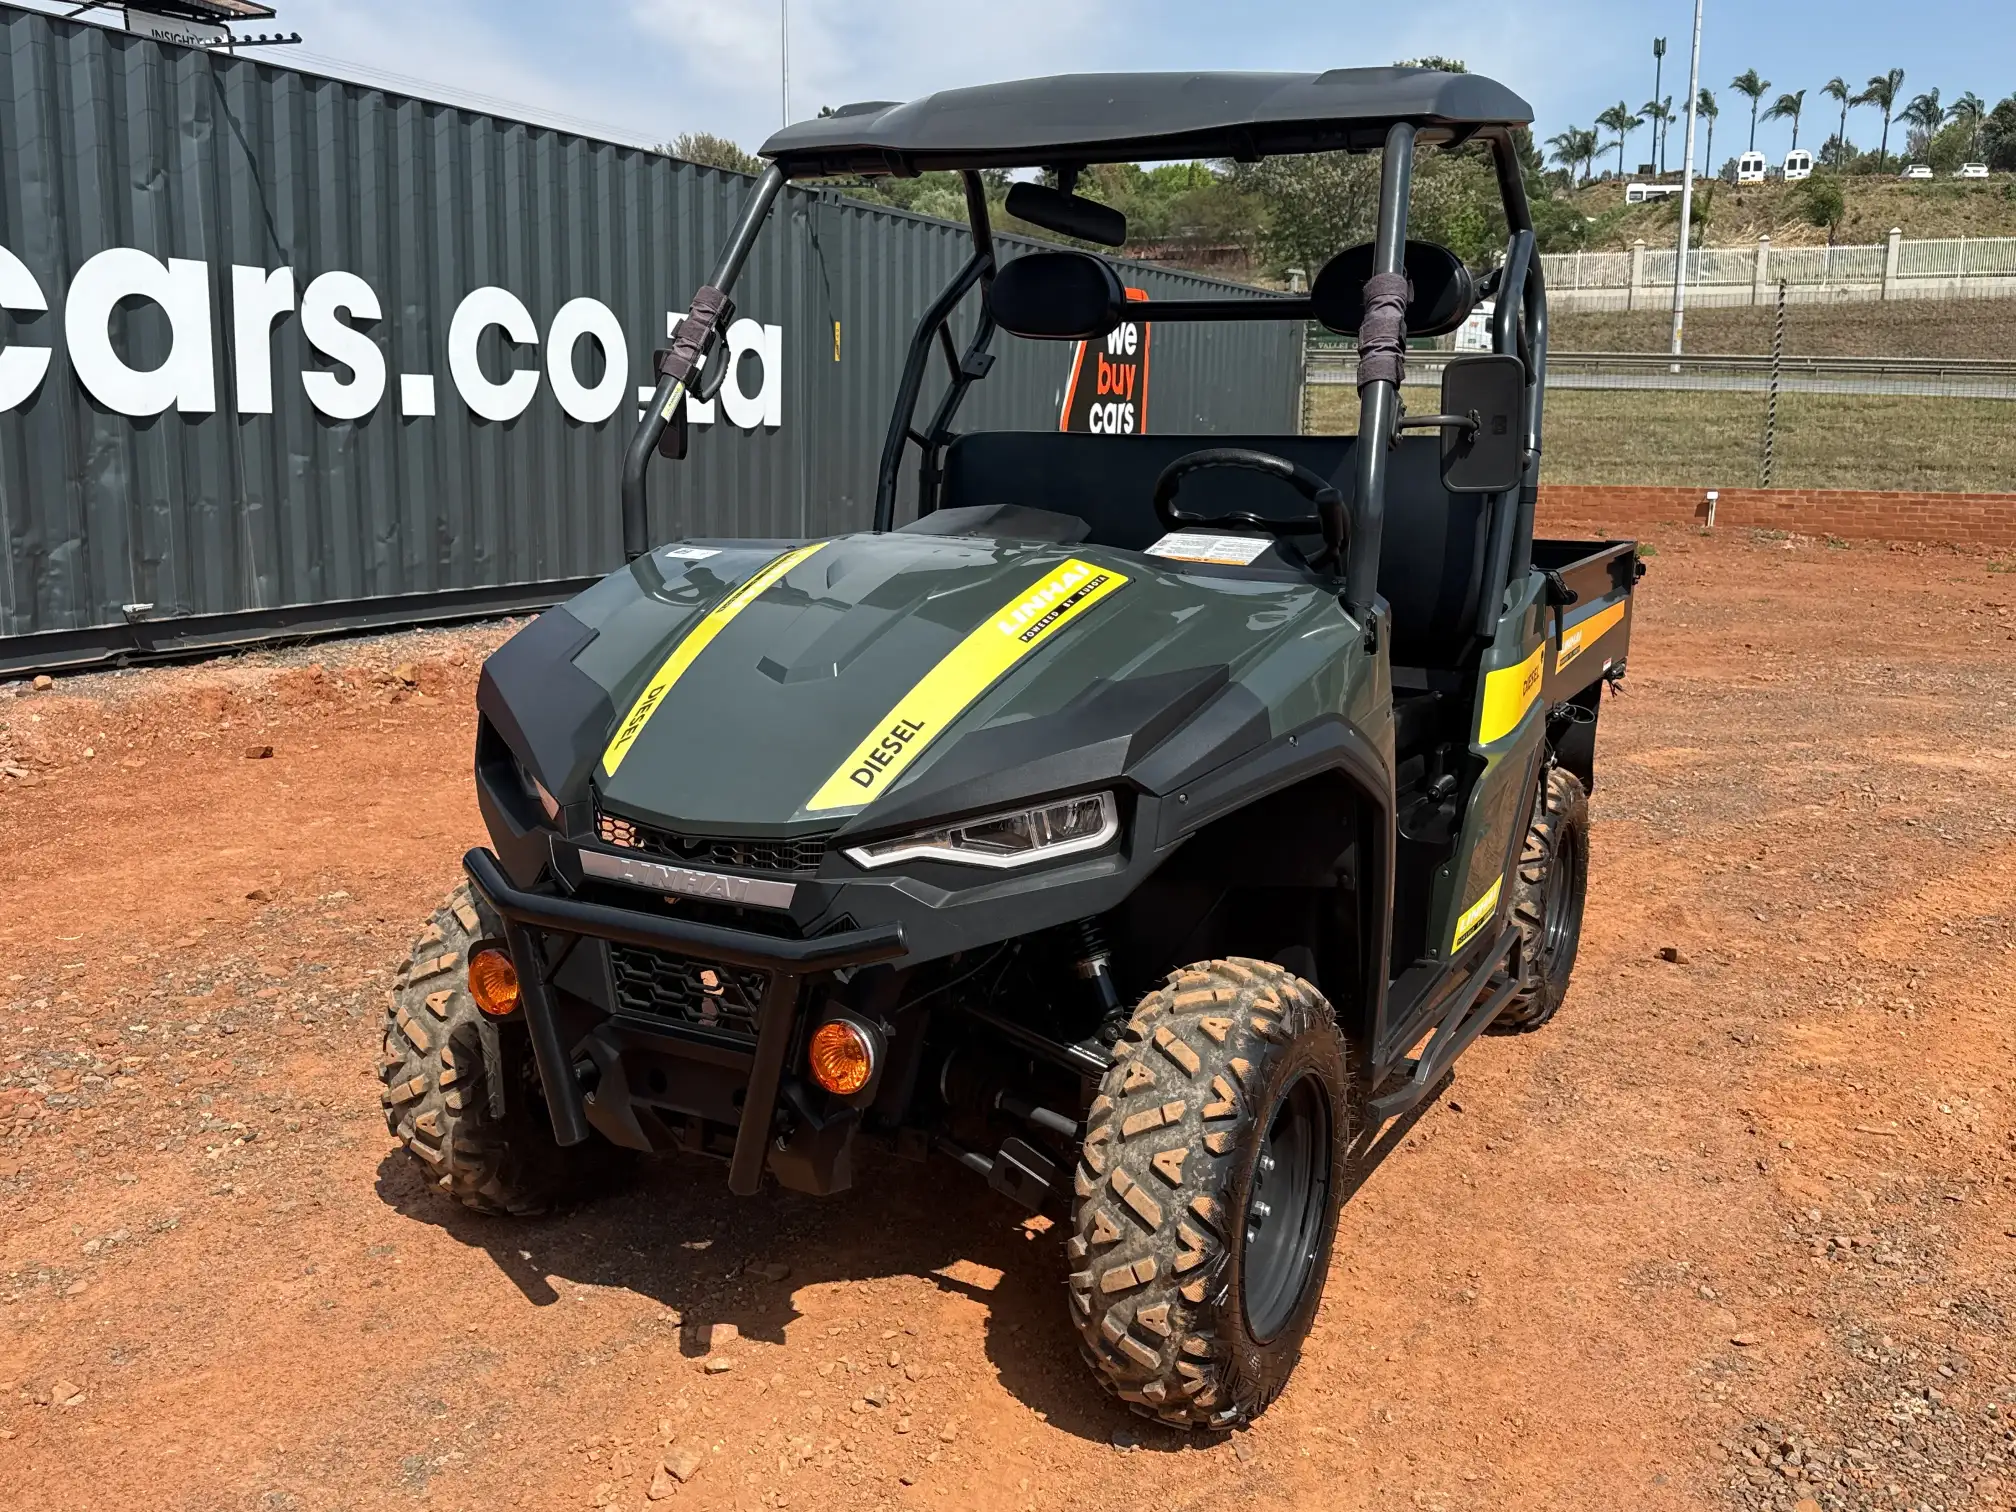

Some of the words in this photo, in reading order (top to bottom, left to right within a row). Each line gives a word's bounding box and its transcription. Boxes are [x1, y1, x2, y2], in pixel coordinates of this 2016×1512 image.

[1107, 322, 1138, 355] we
[1097, 352, 1136, 401] buy
[1089, 403, 1134, 434] cars
[997, 564, 1091, 636] LINHAI
[1021, 610, 1060, 641] POWERED
[1063, 598, 1075, 608] BY
[1077, 575, 1107, 596] KUBOTA
[614, 684, 667, 751] DIESEL
[849, 719, 926, 789] DIESEL
[617, 859, 752, 901] LINHAI
